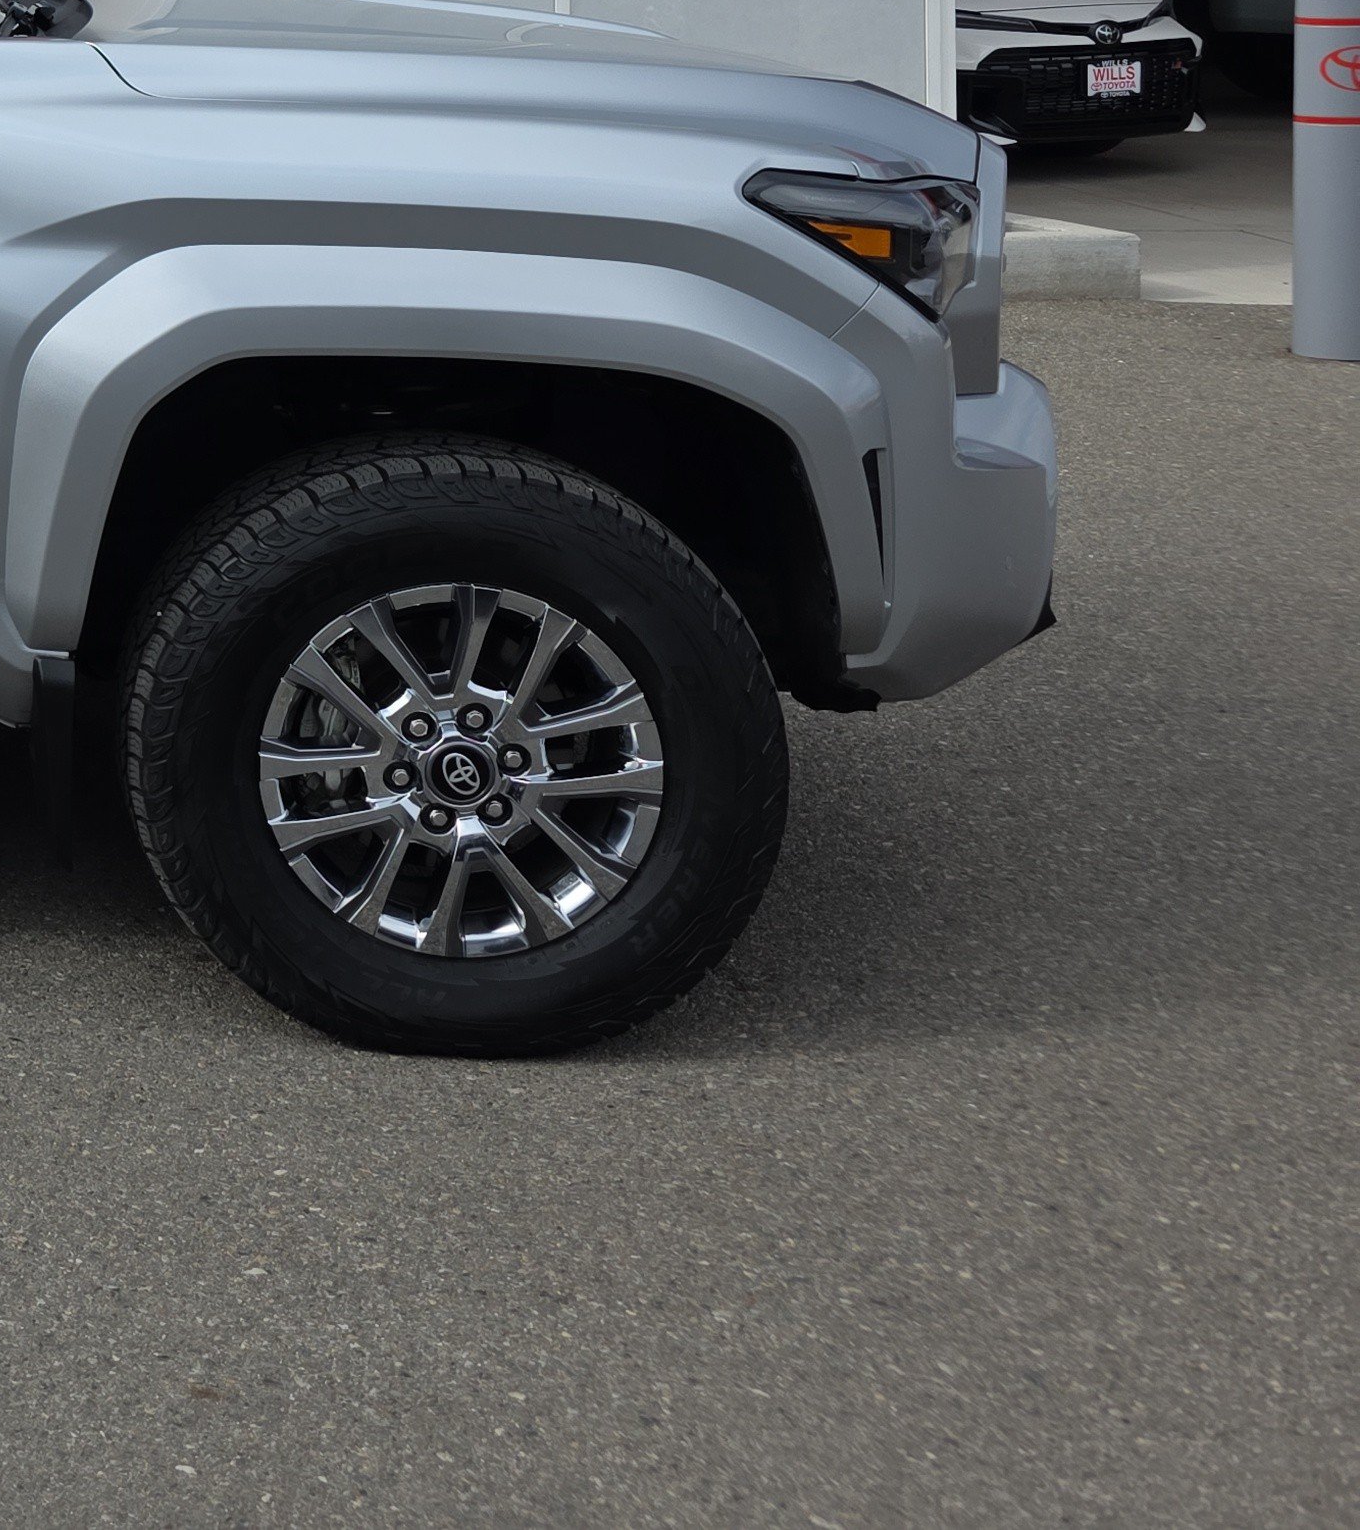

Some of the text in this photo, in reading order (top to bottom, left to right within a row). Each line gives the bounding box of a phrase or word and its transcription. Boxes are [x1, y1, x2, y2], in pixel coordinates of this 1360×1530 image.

[1102, 59, 1128, 67] WILLS
[1093, 66, 1135, 81] WILLS
[1103, 81, 1136, 90] TOYOTA
